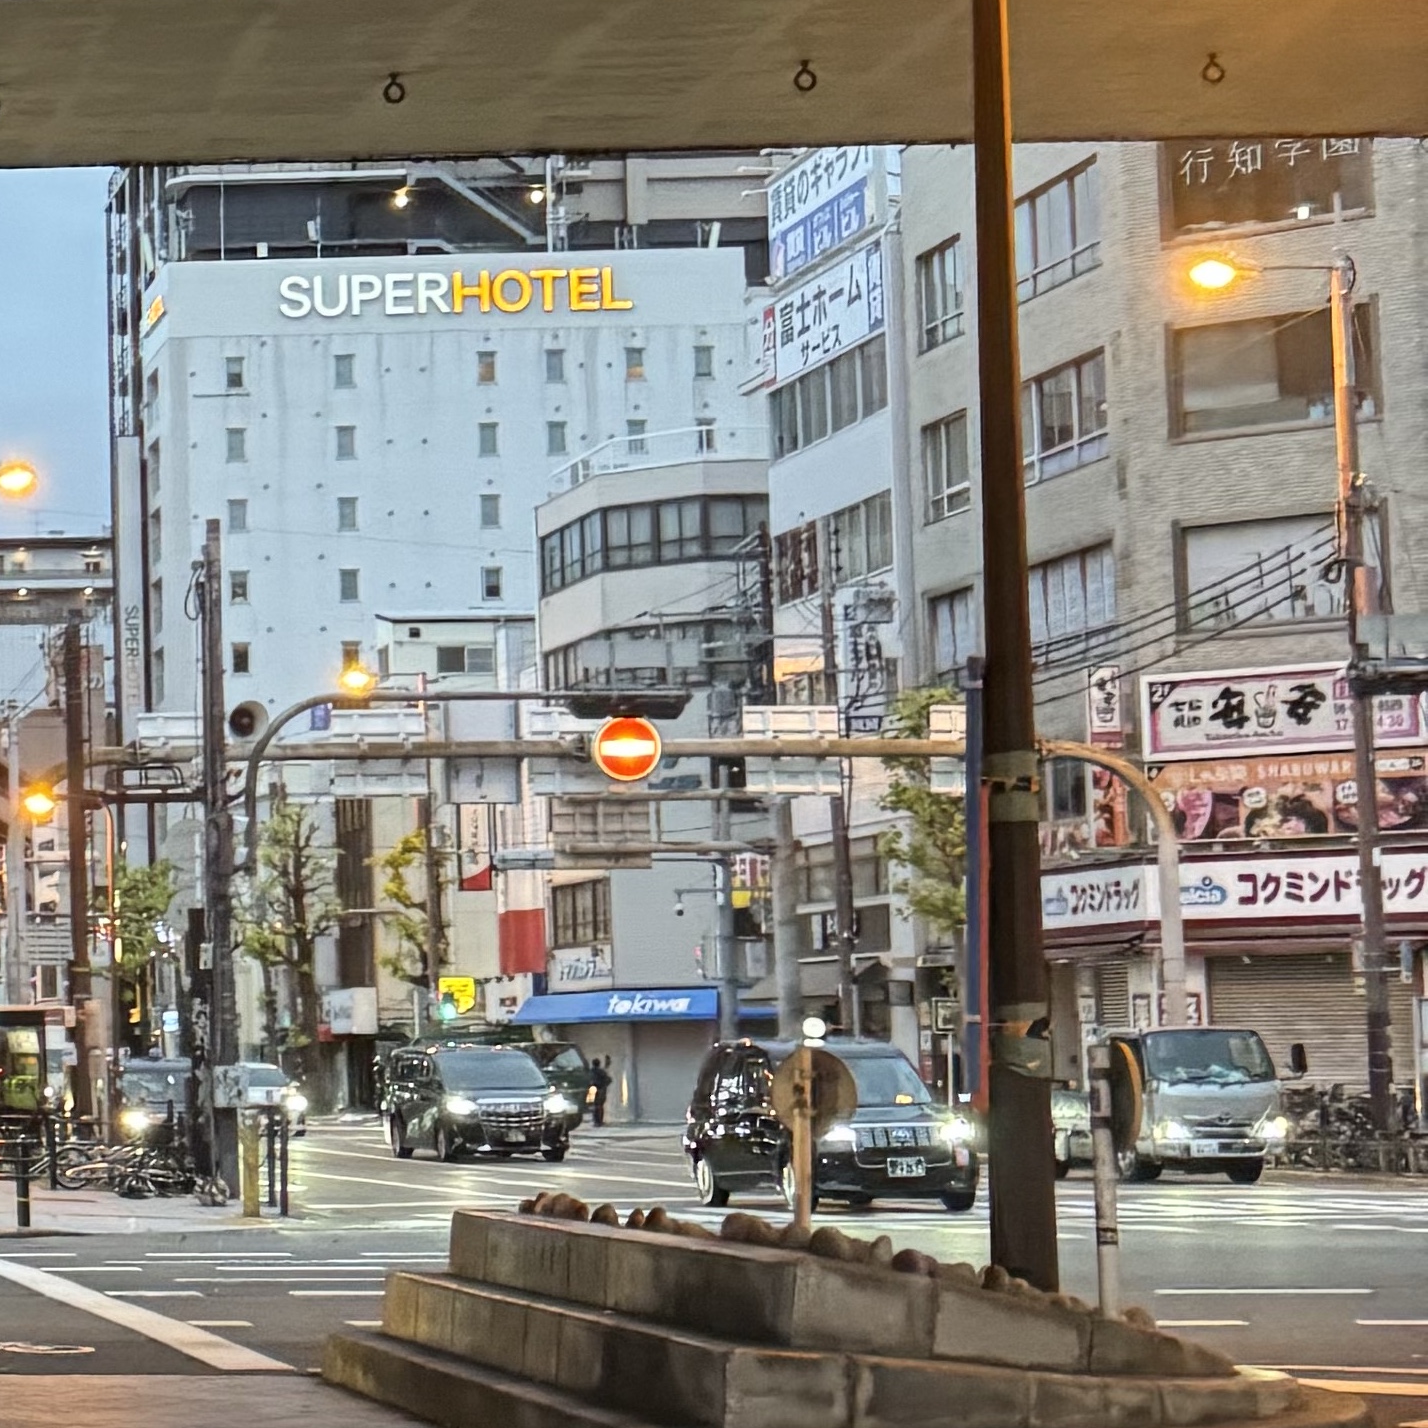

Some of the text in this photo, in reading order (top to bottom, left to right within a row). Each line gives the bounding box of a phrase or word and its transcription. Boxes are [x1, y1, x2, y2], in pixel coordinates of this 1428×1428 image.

[279, 265, 634, 319] SUPERHOTEL
[779, 263, 862, 349] 富士ホーム
[800, 323, 842, 366] サービス
[1237, 866, 1428, 907] コクミンドッグ
[607, 992, 692, 1015] tokiwa
